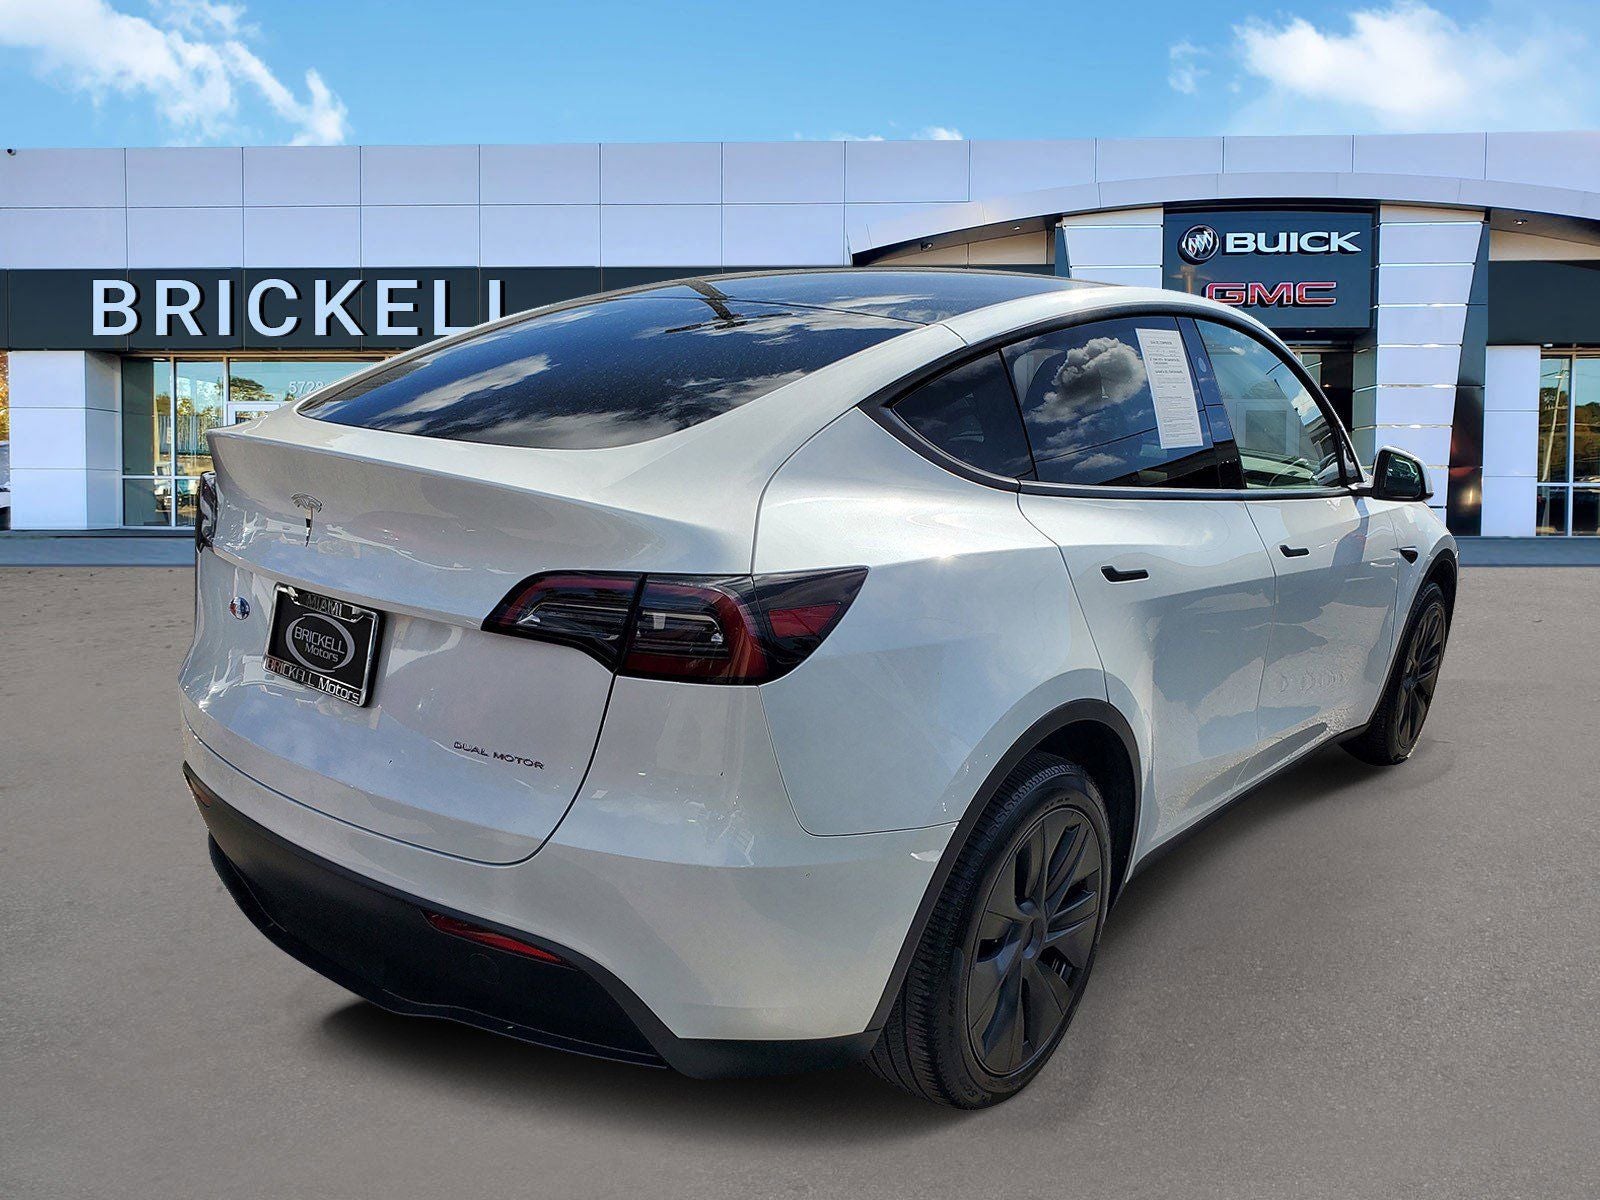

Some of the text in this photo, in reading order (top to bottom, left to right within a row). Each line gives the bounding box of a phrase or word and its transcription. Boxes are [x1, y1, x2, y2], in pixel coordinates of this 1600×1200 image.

[1225, 231, 1362, 253] BUICK
[1206, 281, 1337, 305] GMC
[304, 592, 343, 617] MIAMI
[294, 626, 346, 655] BRICKELL
[304, 642, 339, 663] Motors
[317, 677, 361, 703] Motors
[453, 741, 545, 770] DUAL MOTOR
